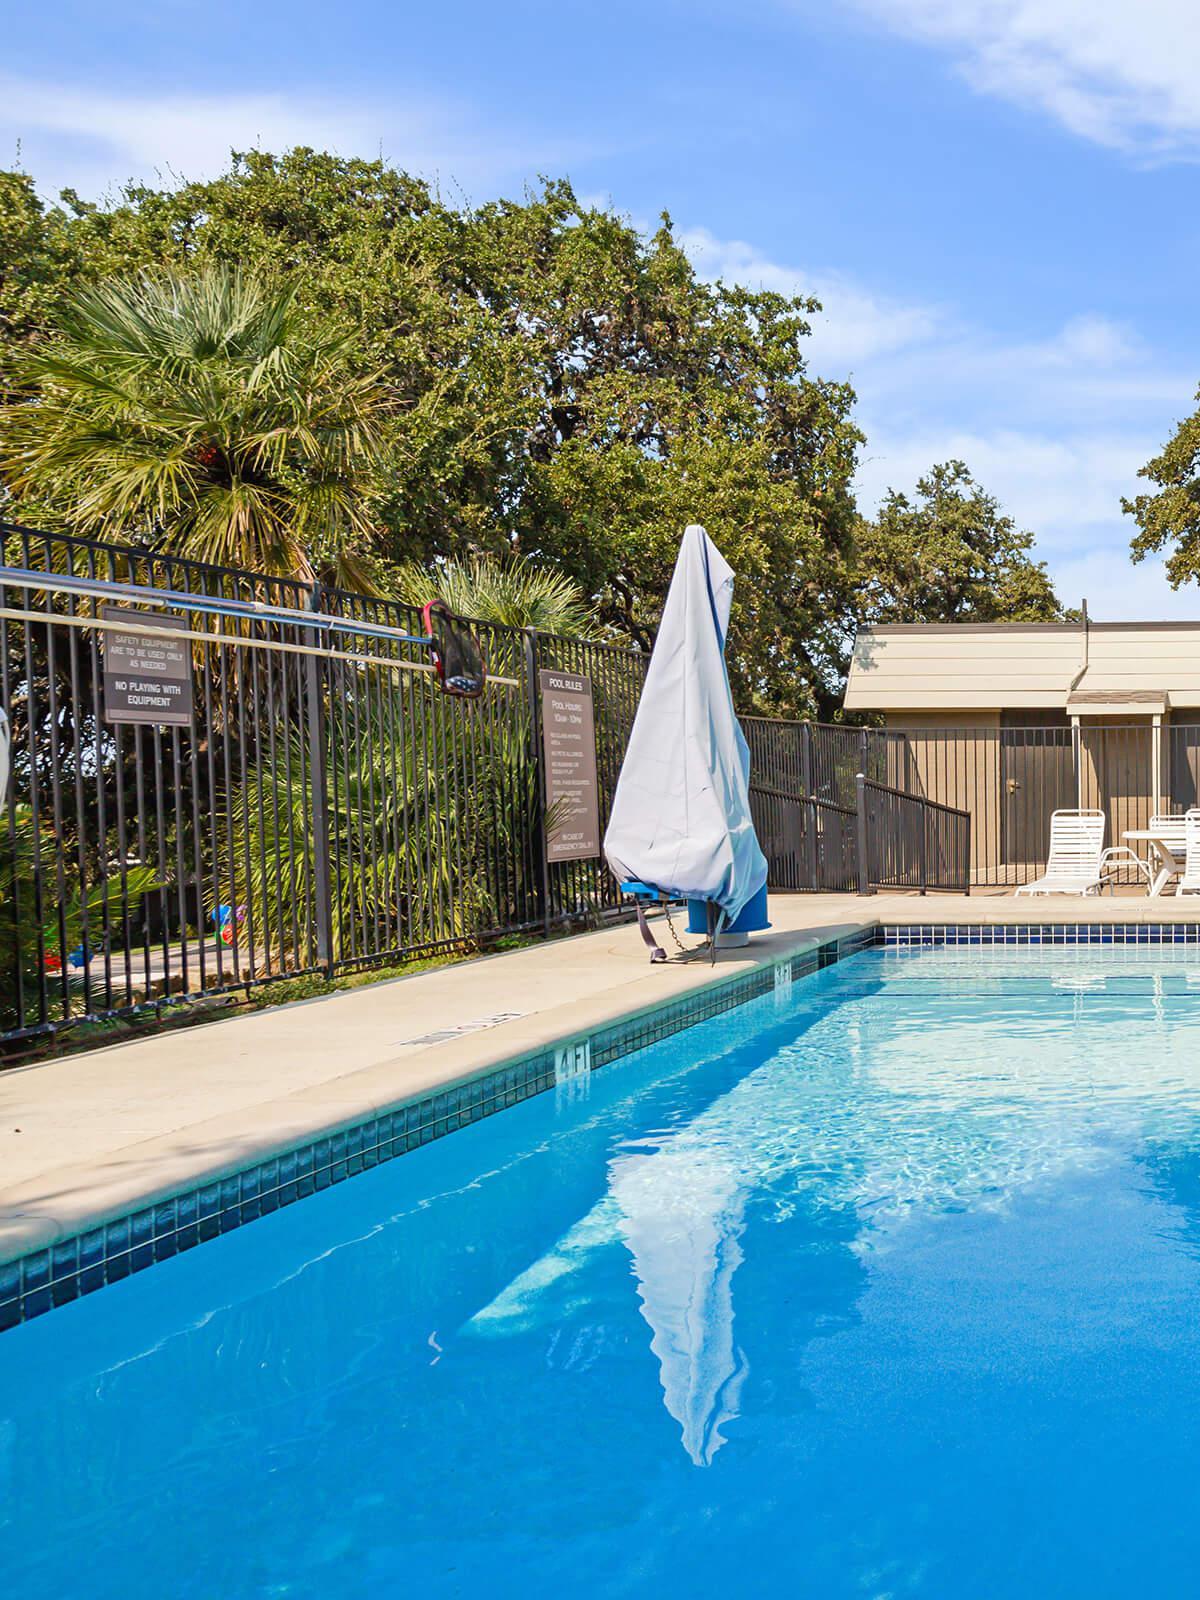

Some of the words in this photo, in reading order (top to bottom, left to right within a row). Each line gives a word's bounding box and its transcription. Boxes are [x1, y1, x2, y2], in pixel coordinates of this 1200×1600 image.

[115, 635, 138, 645] SAFETY
[142, 638, 178, 648] EQUIPMENT
[111, 646, 125, 654] ARE
[126, 647, 136, 656] TO
[137, 648, 146, 657] BE
[148, 650, 165, 659] USED
[166, 651, 183, 660] ONLY
[140, 661, 166, 670] NEEDED
[115, 681, 127, 690] NO
[129, 682, 160, 693] PLAYING
[162, 685, 181, 694] WITH
[549, 678, 565, 688] POOL
[566, 680, 583, 690] RULES
[128, 695, 171, 706] EQUIPMENT
[561, 1048, 569, 1077] 4
